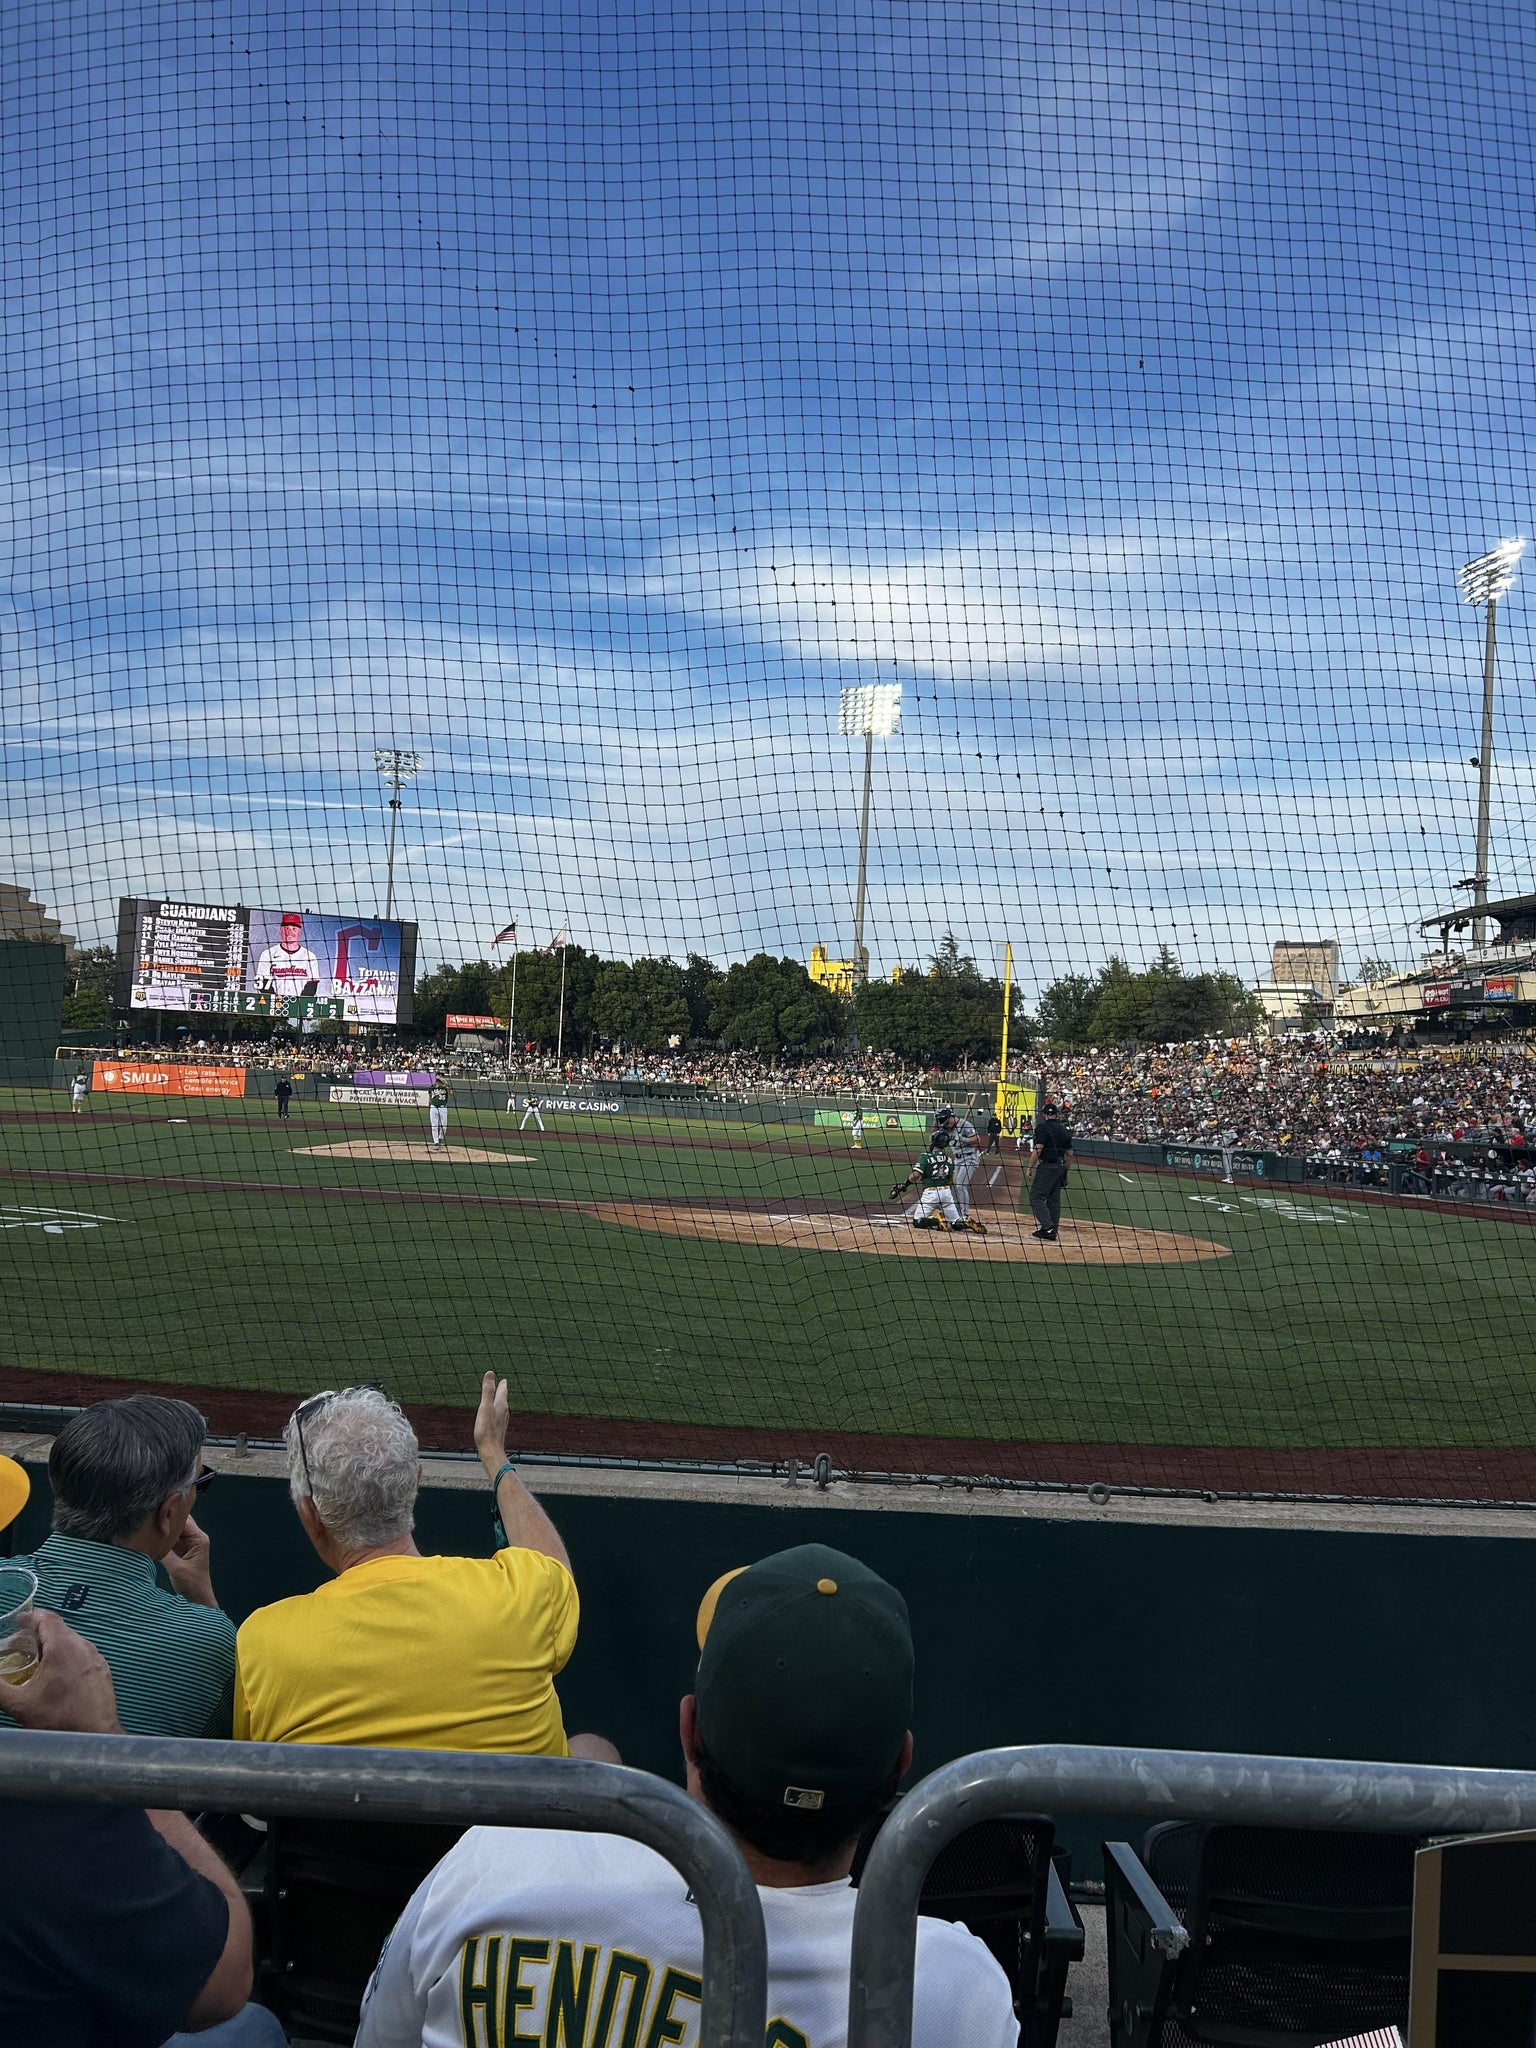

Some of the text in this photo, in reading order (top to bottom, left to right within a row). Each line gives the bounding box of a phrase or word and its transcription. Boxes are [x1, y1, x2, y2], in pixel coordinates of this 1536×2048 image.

[160, 904, 236, 922] GUARDIANS
[254, 975, 273, 990] 37
[331, 978, 395, 999] BAZZANA
[246, 997, 255, 1010] 2
[307, 1008, 313, 1017] 2
[329, 1009, 336, 1018] 2
[121, 1072, 169, 1085] SMUD
[523, 1098, 619, 1112] SY RIVER CASINO
